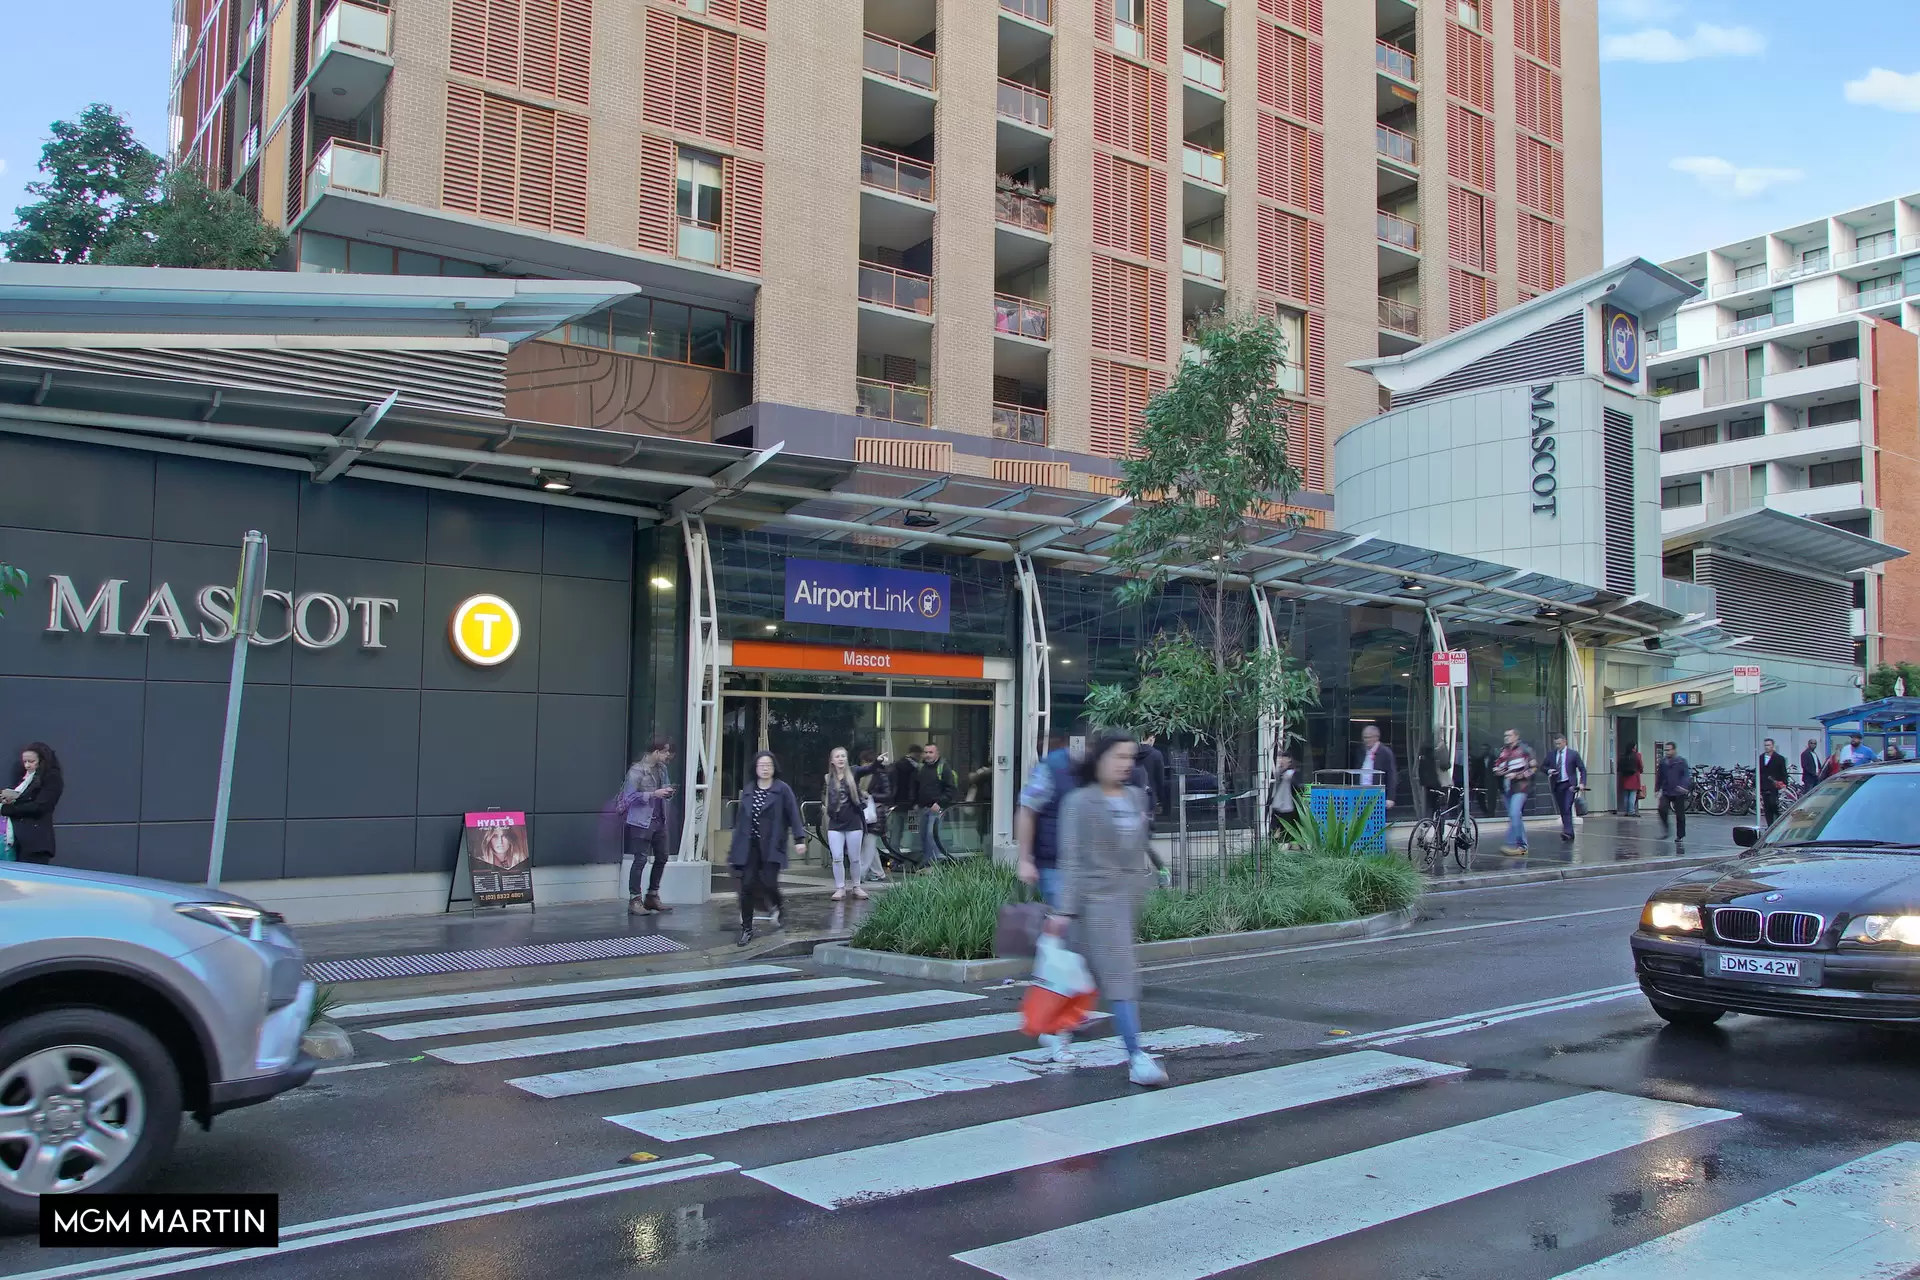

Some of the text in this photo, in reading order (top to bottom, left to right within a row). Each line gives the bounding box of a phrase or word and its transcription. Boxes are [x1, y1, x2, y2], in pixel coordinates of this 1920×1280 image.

[1530, 382, 1557, 517] MASCOT
[794, 579, 914, 613] AirportLink
[474, 613, 501, 651] T
[843, 650, 891, 668] Mascot
[477, 816, 514, 827] HYATT'S
